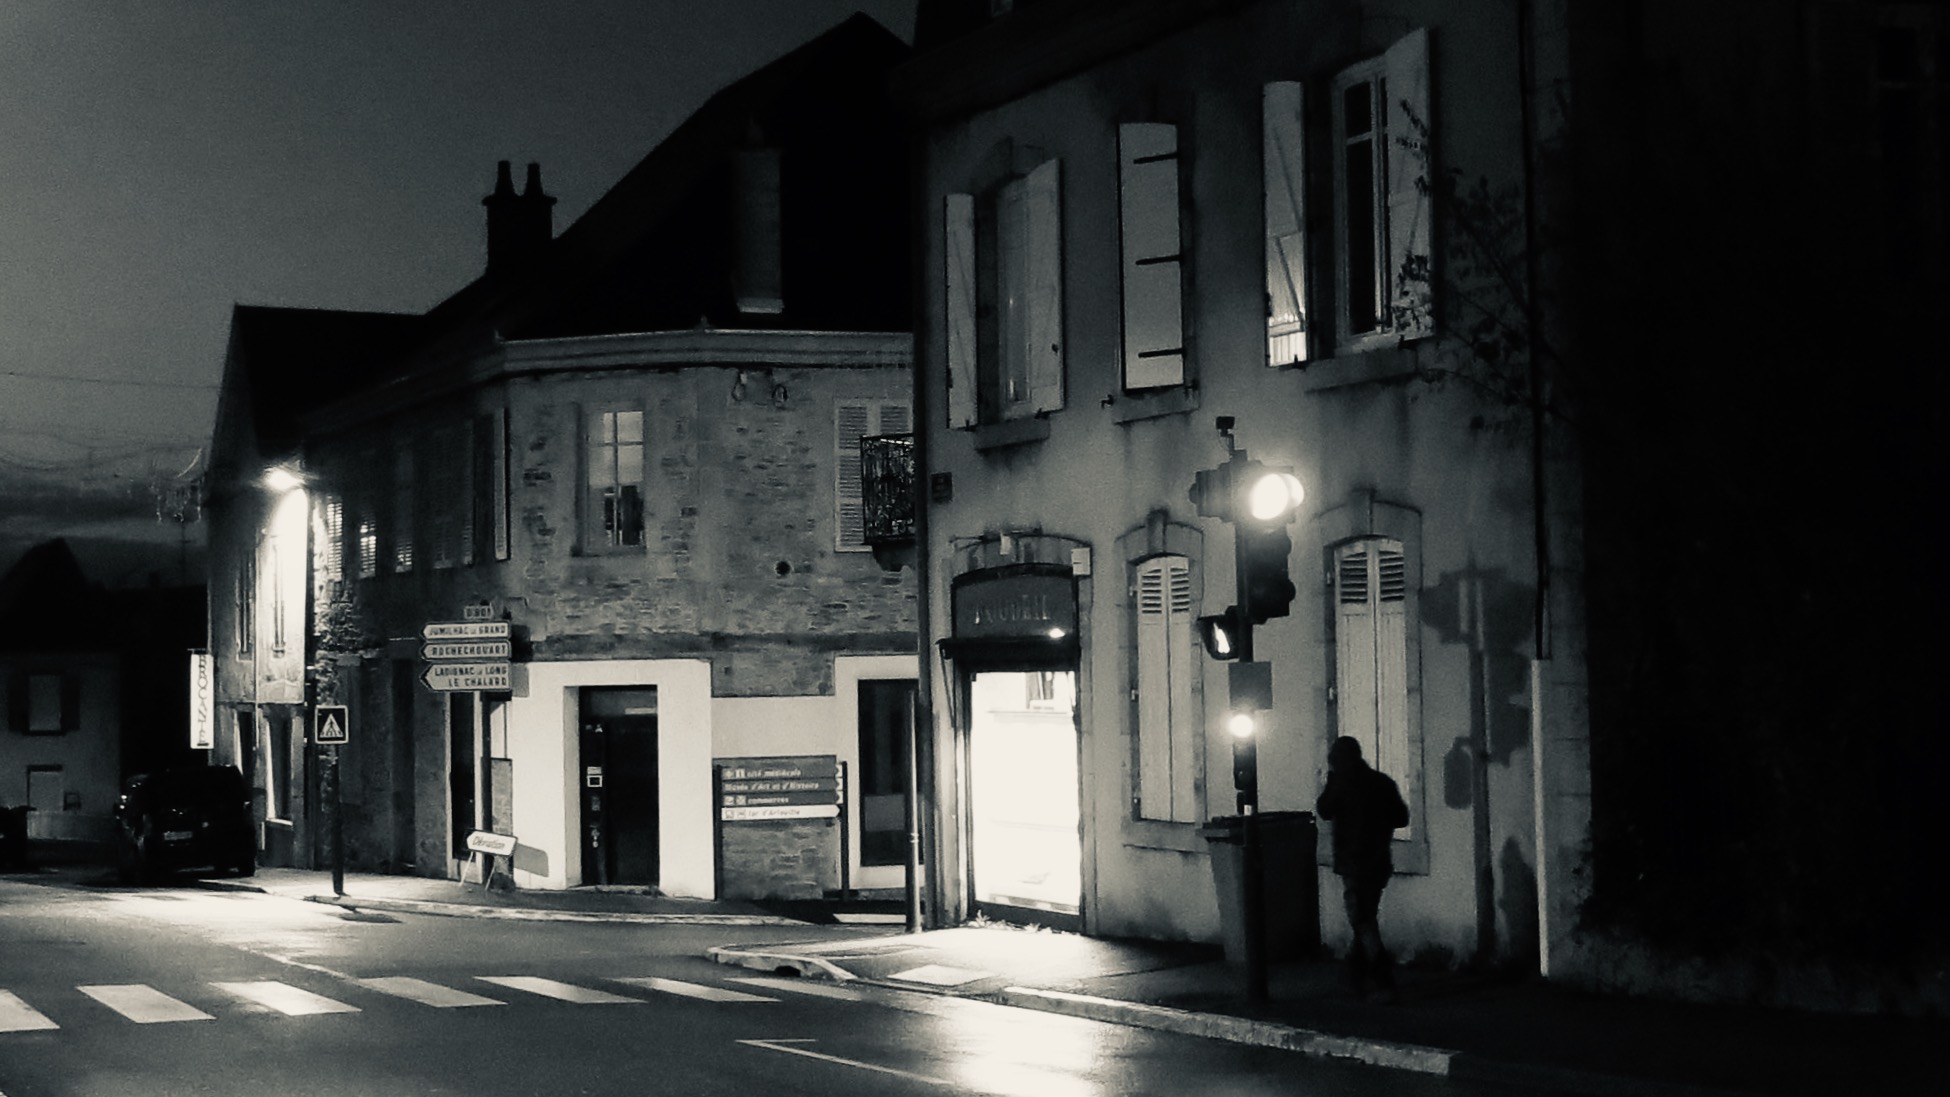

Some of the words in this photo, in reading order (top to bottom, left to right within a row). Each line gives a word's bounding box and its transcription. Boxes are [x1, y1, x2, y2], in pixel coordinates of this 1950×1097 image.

[478, 624, 506, 635] GRAND
[432, 644, 506, 656] ROCHECHOUART
[434, 666, 475, 677] LADIGNAC
[485, 665, 507, 675] LONG
[448, 677, 460, 688] LE
[464, 676, 507, 687] CHALARD
